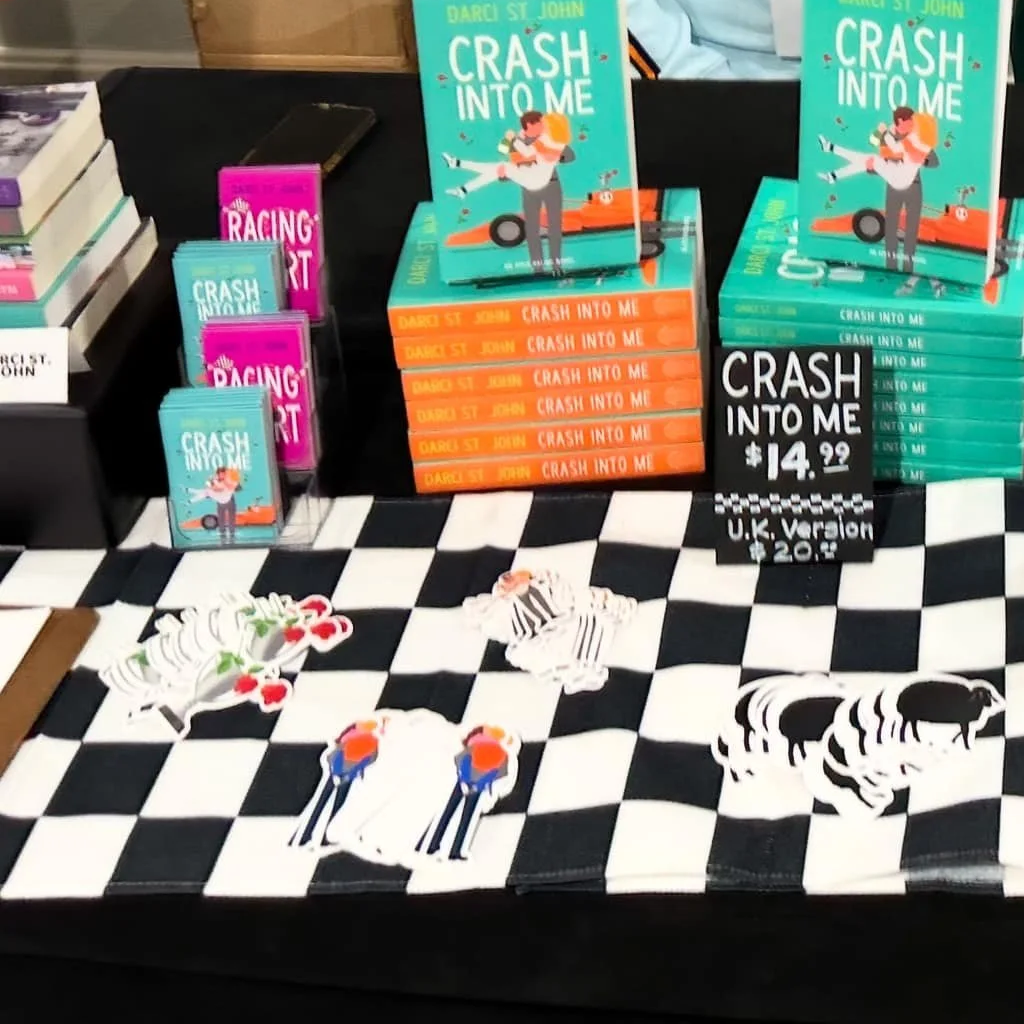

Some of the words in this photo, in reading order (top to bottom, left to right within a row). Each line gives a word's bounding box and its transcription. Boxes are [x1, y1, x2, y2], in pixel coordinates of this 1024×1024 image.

[447, 5, 498, 24] DARCI
[507, 3, 527, 21] ST
[538, 0, 585, 20] JOHN
[449, 30, 591, 82] CRASH
[835, 17, 964, 81] CRASH
[456, 79, 534, 121] INTO
[544, 78, 595, 115] ME
[837, 67, 907, 112] INTO
[919, 77, 962, 122] ME
[227, 209, 313, 244] RACING
[193, 279, 260, 306] CRASH
[198, 302, 233, 320] INTO
[521, 301, 570, 323] CRASH
[577, 299, 612, 319] INTO
[618, 298, 640, 317] ME
[840, 308, 875, 324] CRASH
[879, 310, 905, 325] INTO
[910, 312, 925, 326] ME
[527, 333, 575, 353] CRASH
[582, 330, 616, 349] INTO
[622, 328, 644, 346] ME
[839, 332, 874, 347] CRASH
[878, 334, 904, 348] INTO
[909, 336, 925, 350] ME
[533, 367, 581, 388] CRASH
[587, 364, 622, 383] INTO
[627, 361, 649, 380] ME
[721, 350, 861, 399] CRASH
[881, 354, 906, 368] INTO
[911, 356, 926, 369] ME
[213, 364, 300, 400] RACING
[912, 380, 927, 393] ME
[536, 396, 583, 416] CRASH
[590, 393, 624, 412] INTO
[630, 390, 651, 408] ME
[911, 401, 926, 414] ME
[726, 403, 803, 436] INTO
[813, 403, 862, 436] ME
[182, 431, 250, 453] CRASH
[537, 429, 585, 450] CRASH
[591, 425, 624, 444] INTO
[631, 423, 652, 442] ME
[541, 460, 588, 480] CRASH
[594, 456, 627, 475] INTO
[633, 452, 654, 471] ME
[745, 441, 851, 481] $14.99
[728, 517, 775, 541] U.K.
[781, 513, 874, 541] Version
